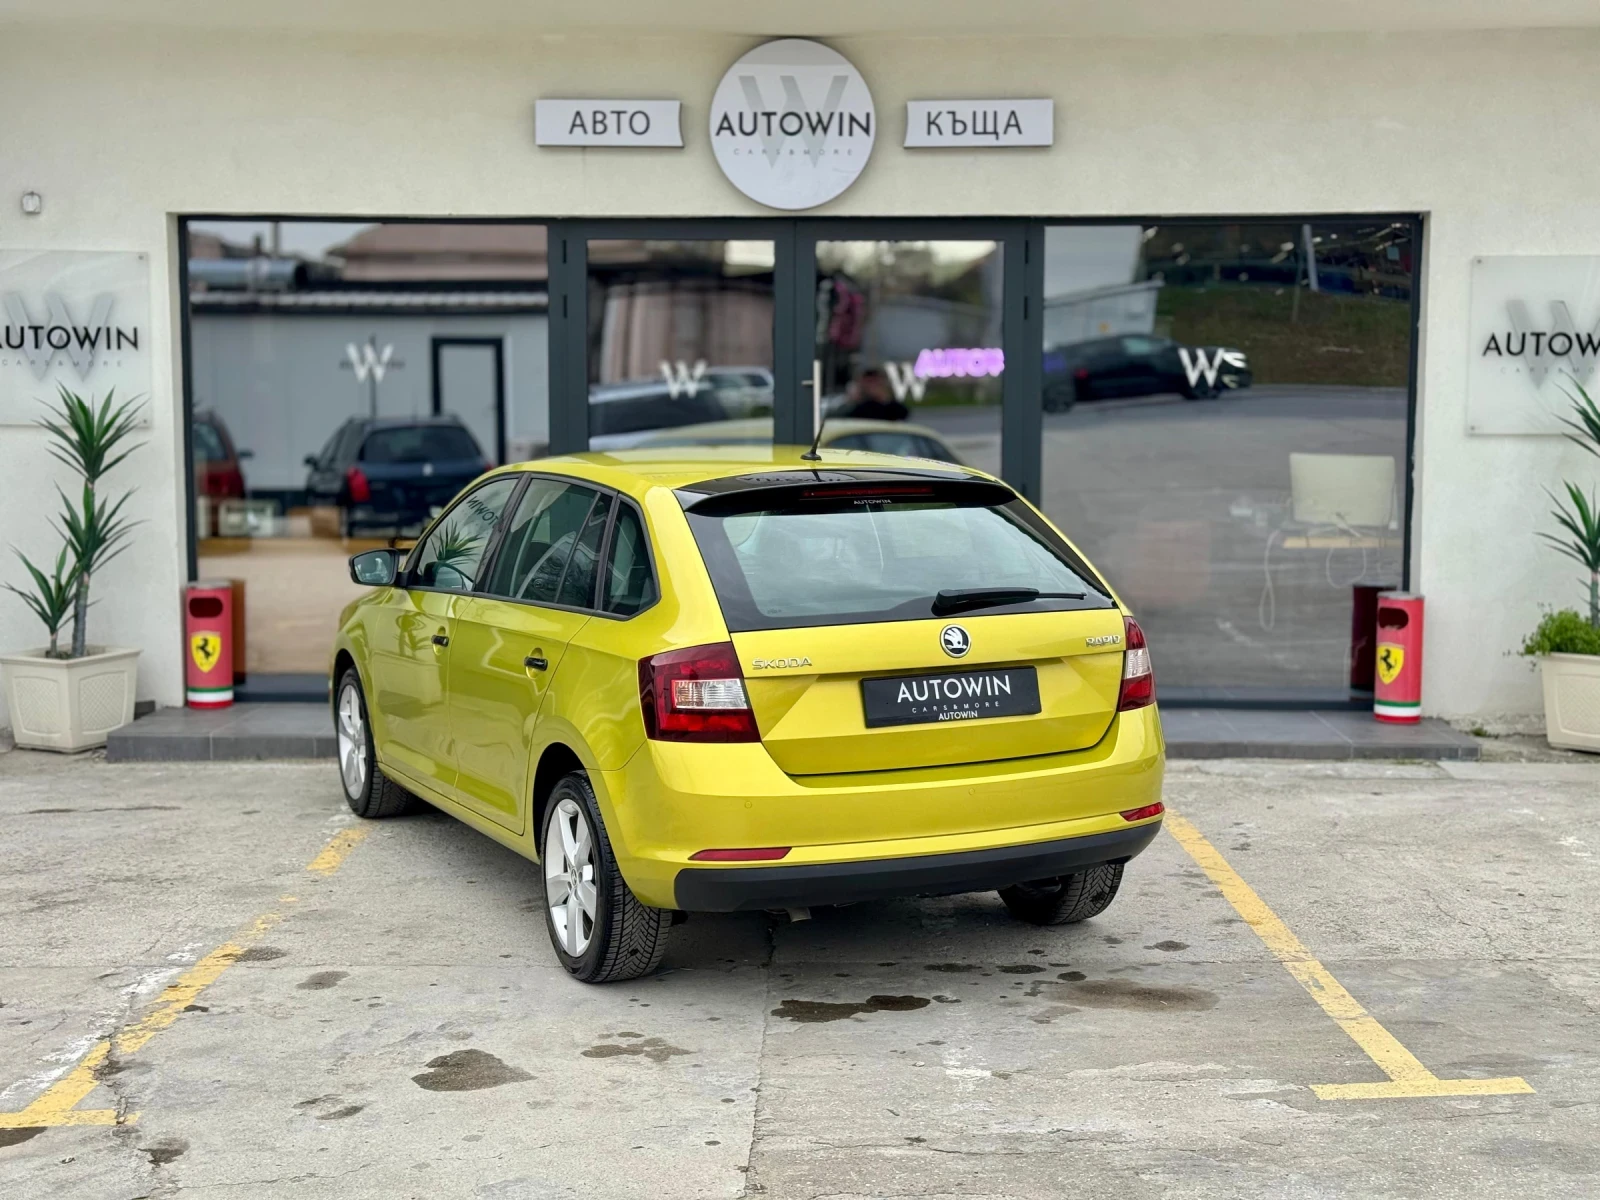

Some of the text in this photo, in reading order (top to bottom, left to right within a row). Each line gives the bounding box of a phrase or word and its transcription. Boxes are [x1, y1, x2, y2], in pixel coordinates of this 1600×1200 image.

[568, 110, 651, 136] АВТО
[715, 111, 871, 137] AUTOWIN
[926, 109, 1023, 141] КЪЩА
[0, 325, 139, 351] UTOWIN
[660, 359, 706, 400] W
[1178, 348, 1225, 389] W
[1085, 634, 1121, 647] RAPID
[897, 674, 1012, 703] AUTOWIN
[938, 710, 979, 721] AUTOWIN
